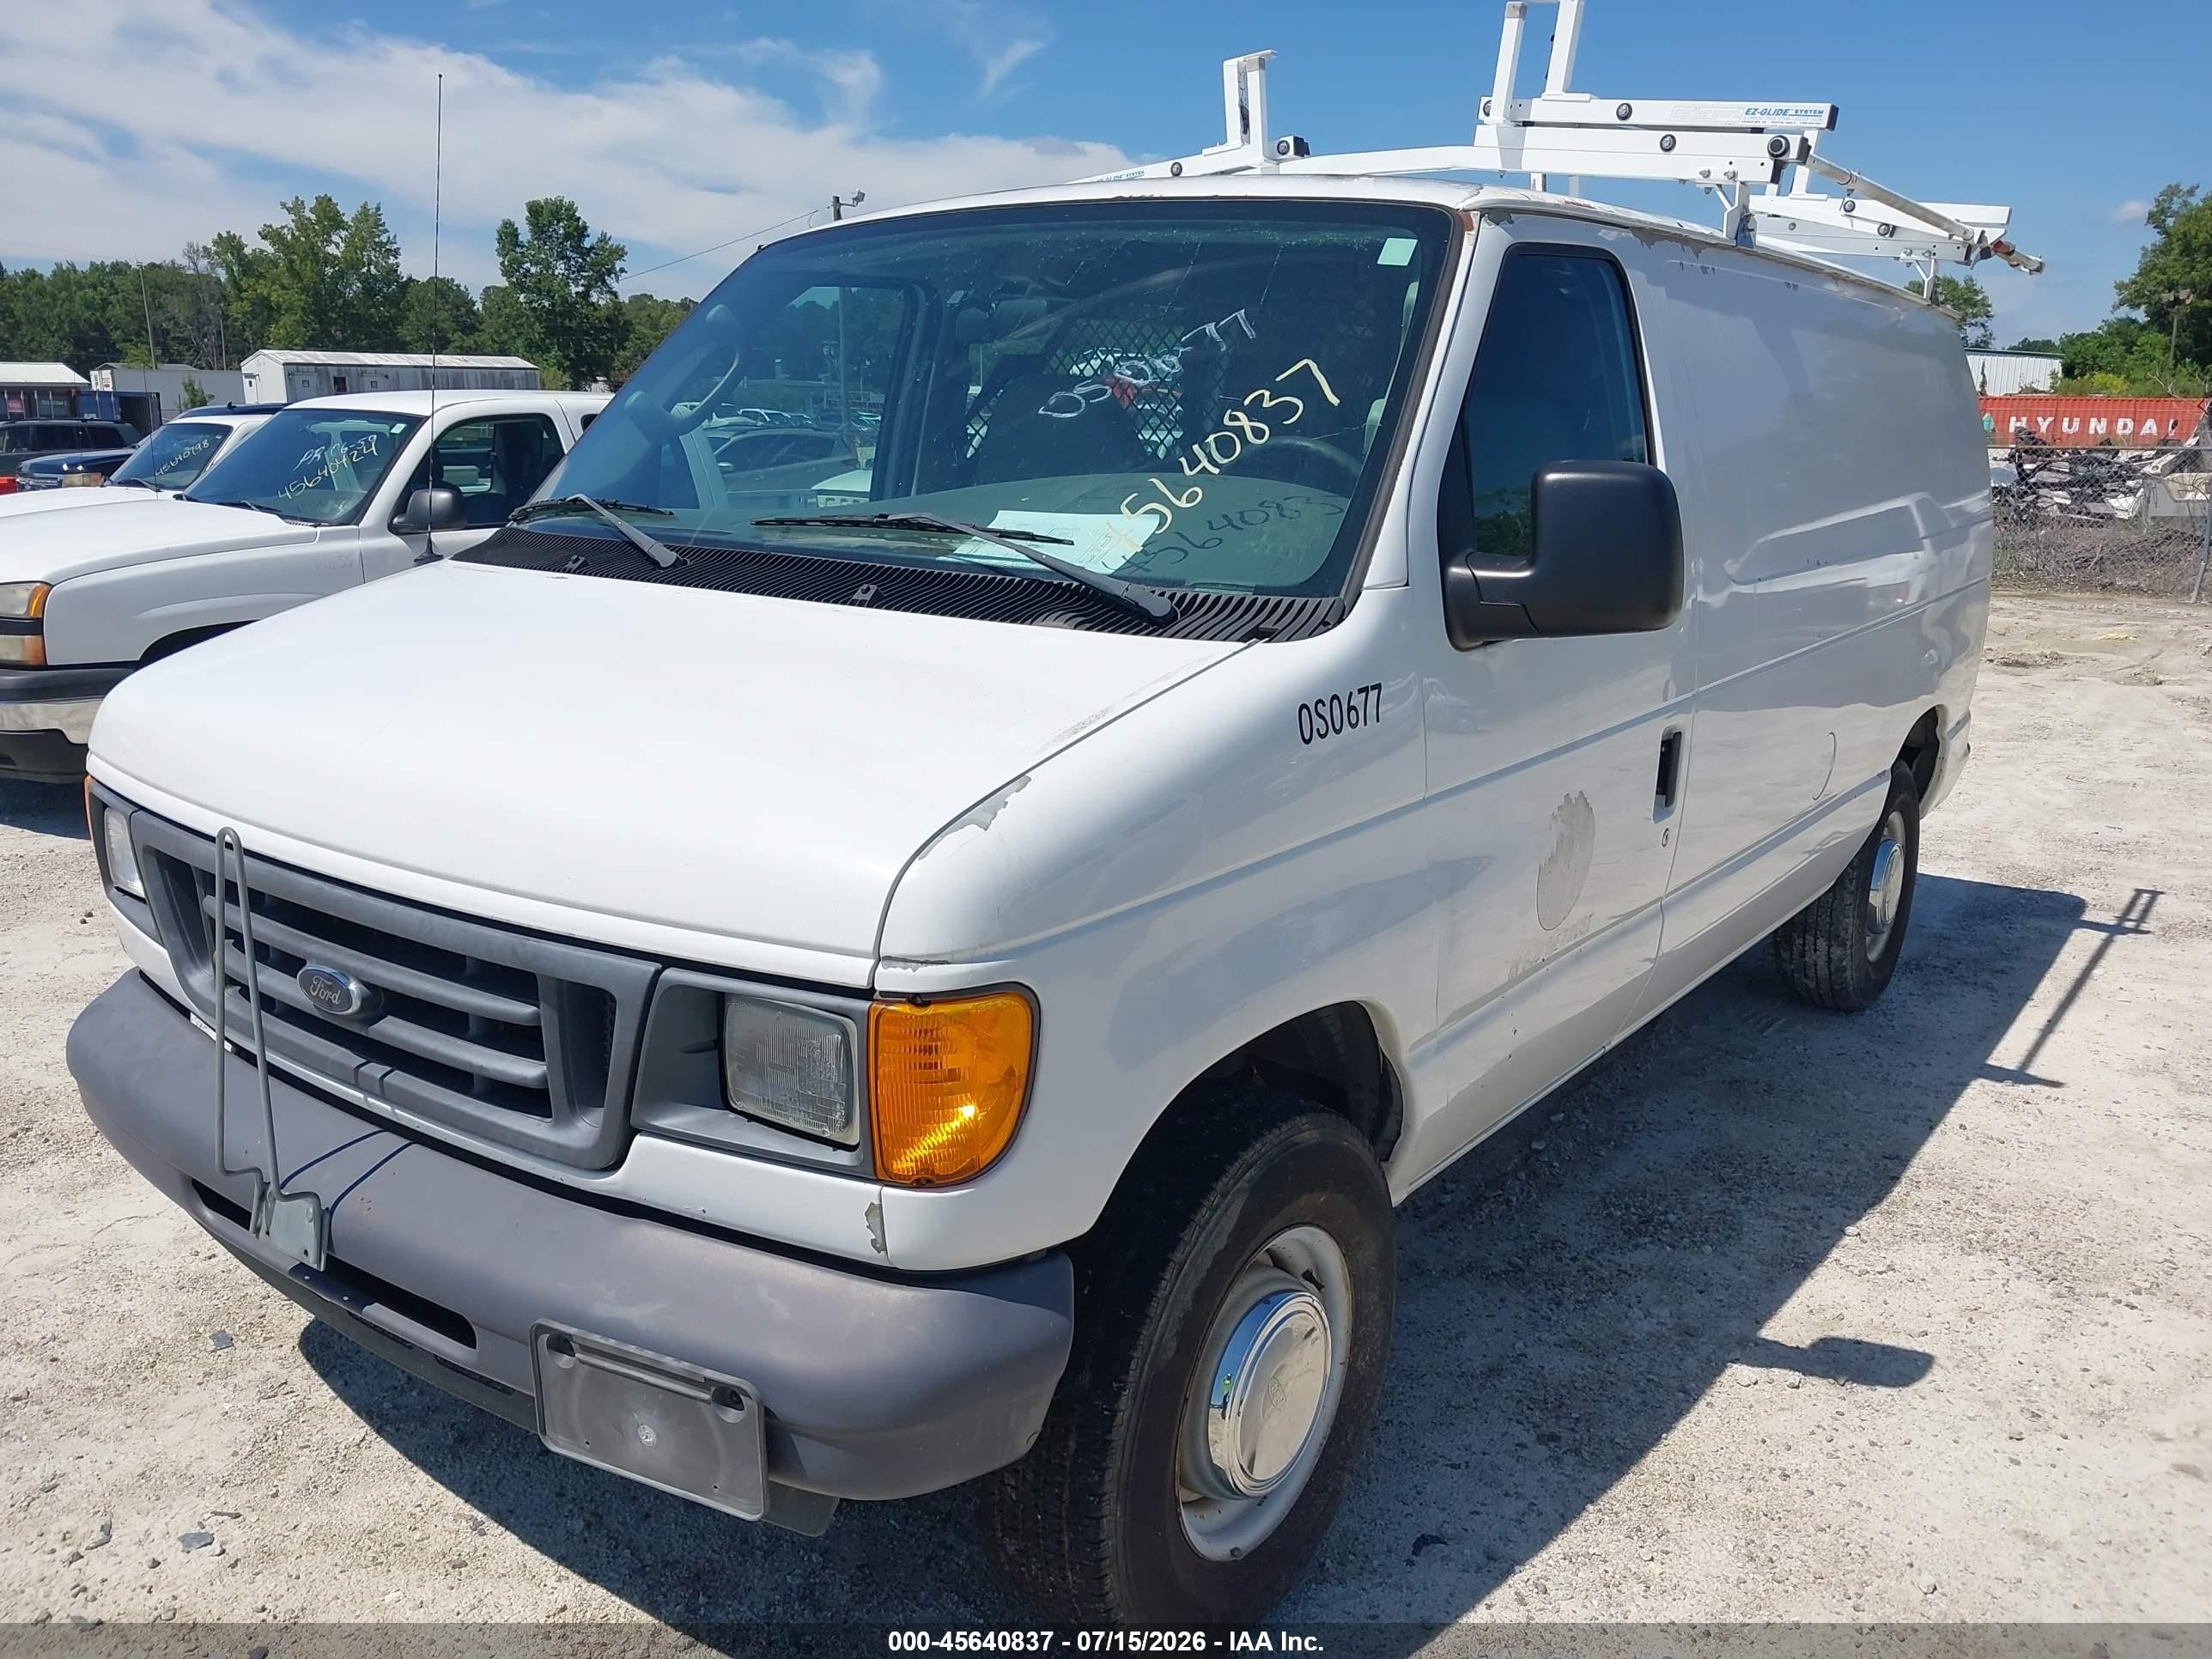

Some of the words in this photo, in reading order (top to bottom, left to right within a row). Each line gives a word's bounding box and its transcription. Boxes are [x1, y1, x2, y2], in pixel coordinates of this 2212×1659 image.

[1745, 107, 1790, 117] EZ-GLIDE
[2008, 416, 2179, 436] HYUNDAI
[1104, 357, 1341, 551] 45640837
[310, 975, 342, 1005] Ford
